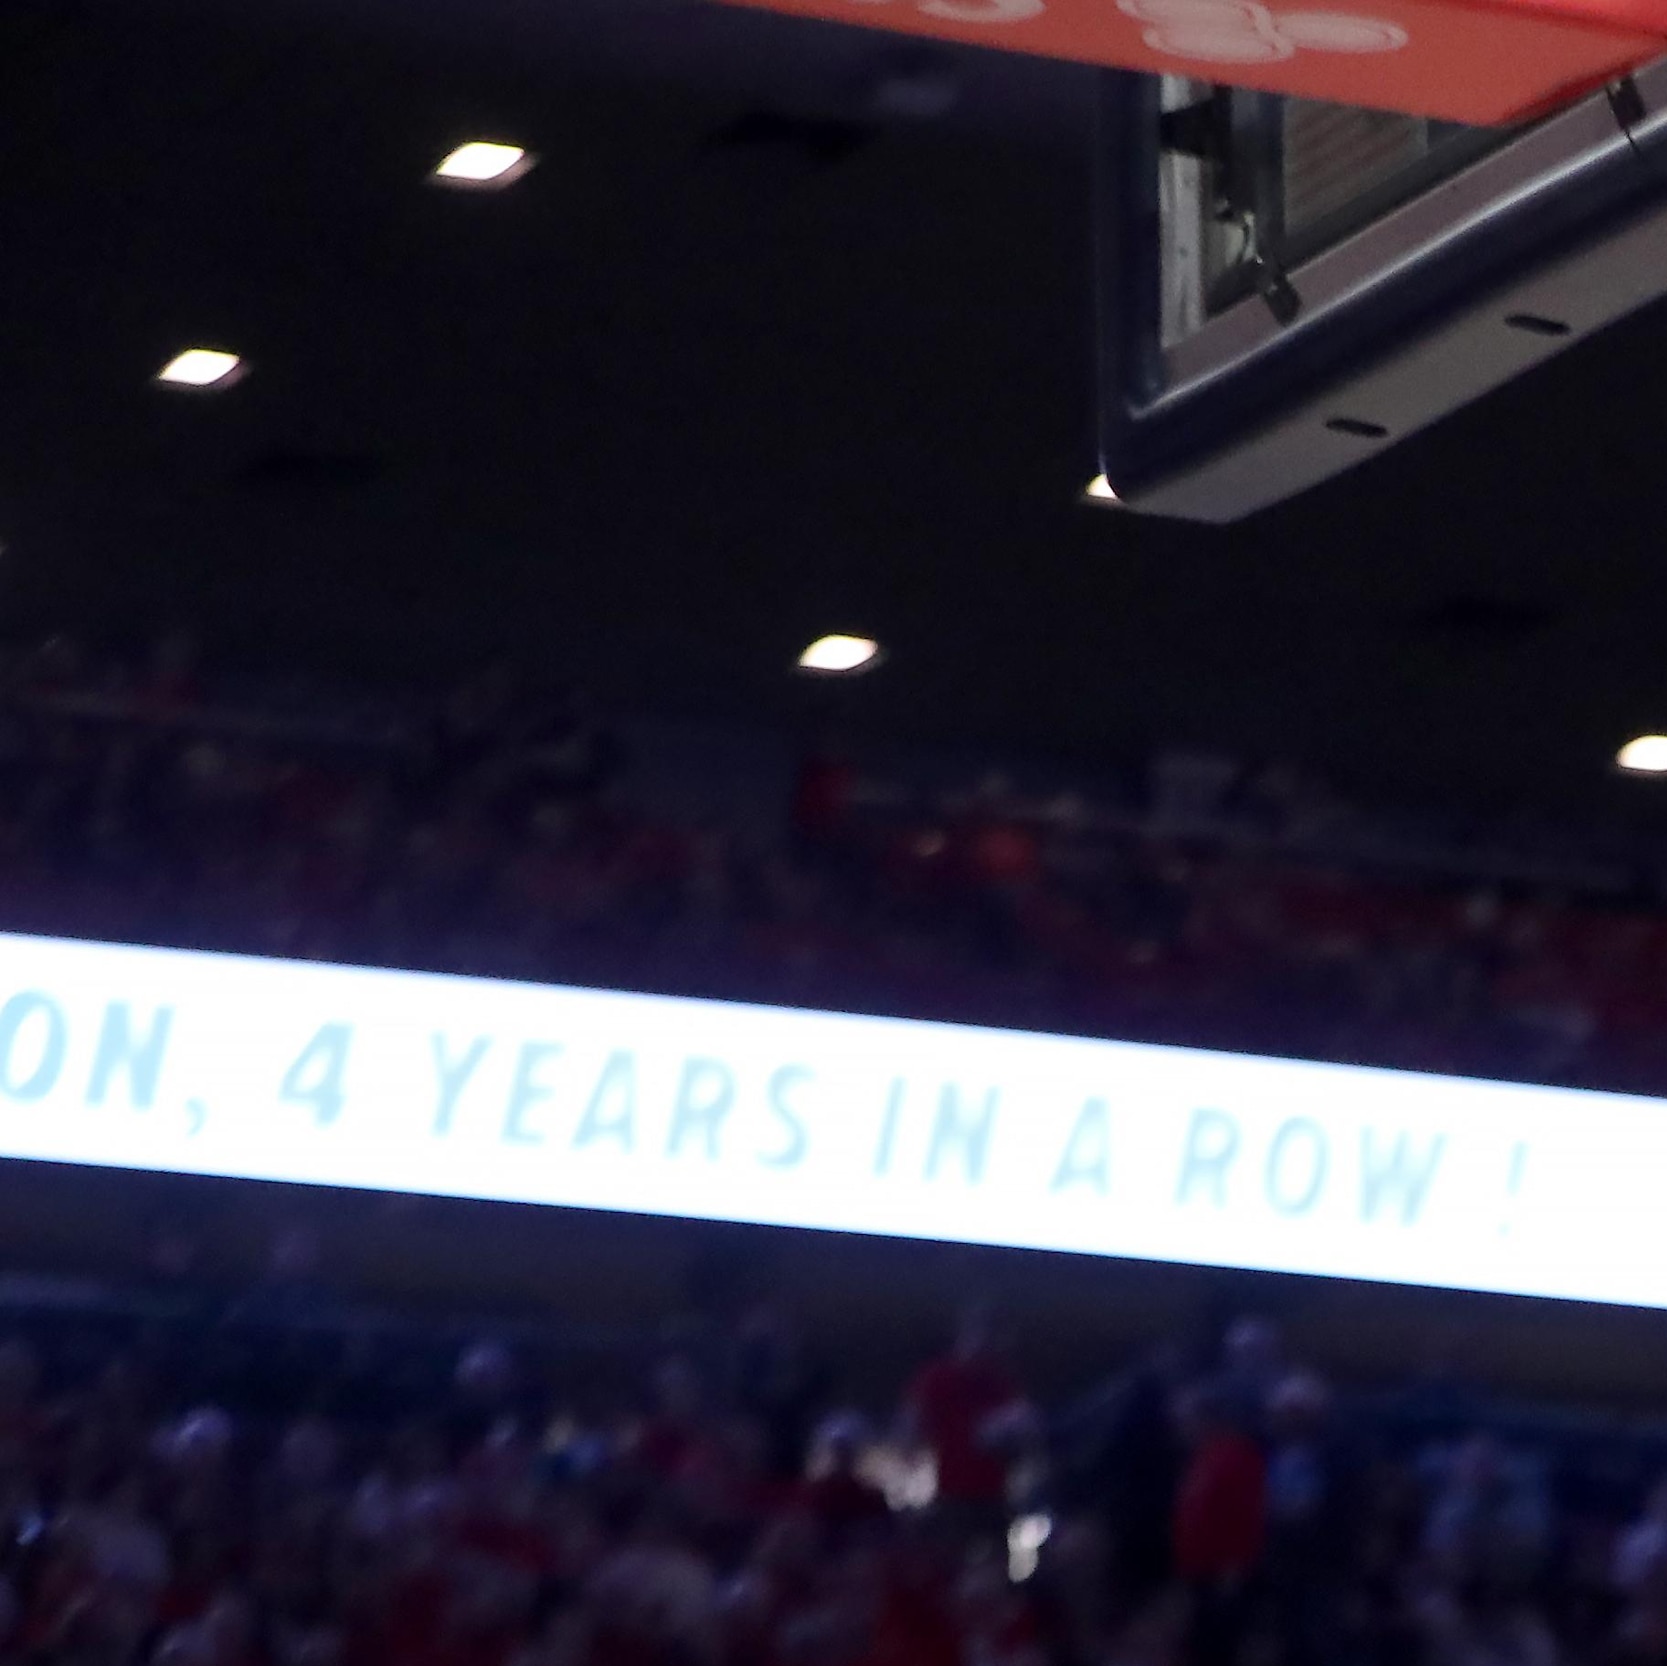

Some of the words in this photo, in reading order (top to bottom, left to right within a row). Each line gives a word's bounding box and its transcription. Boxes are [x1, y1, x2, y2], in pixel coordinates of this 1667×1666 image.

[0, 987, 209, 1138] ON,
[278, 1018, 357, 1130] 4
[428, 1029, 819, 1171] YEARS
[869, 1073, 1003, 1188] IN
[1047, 1094, 1112, 1197] A
[1172, 1104, 1452, 1229] ROW
